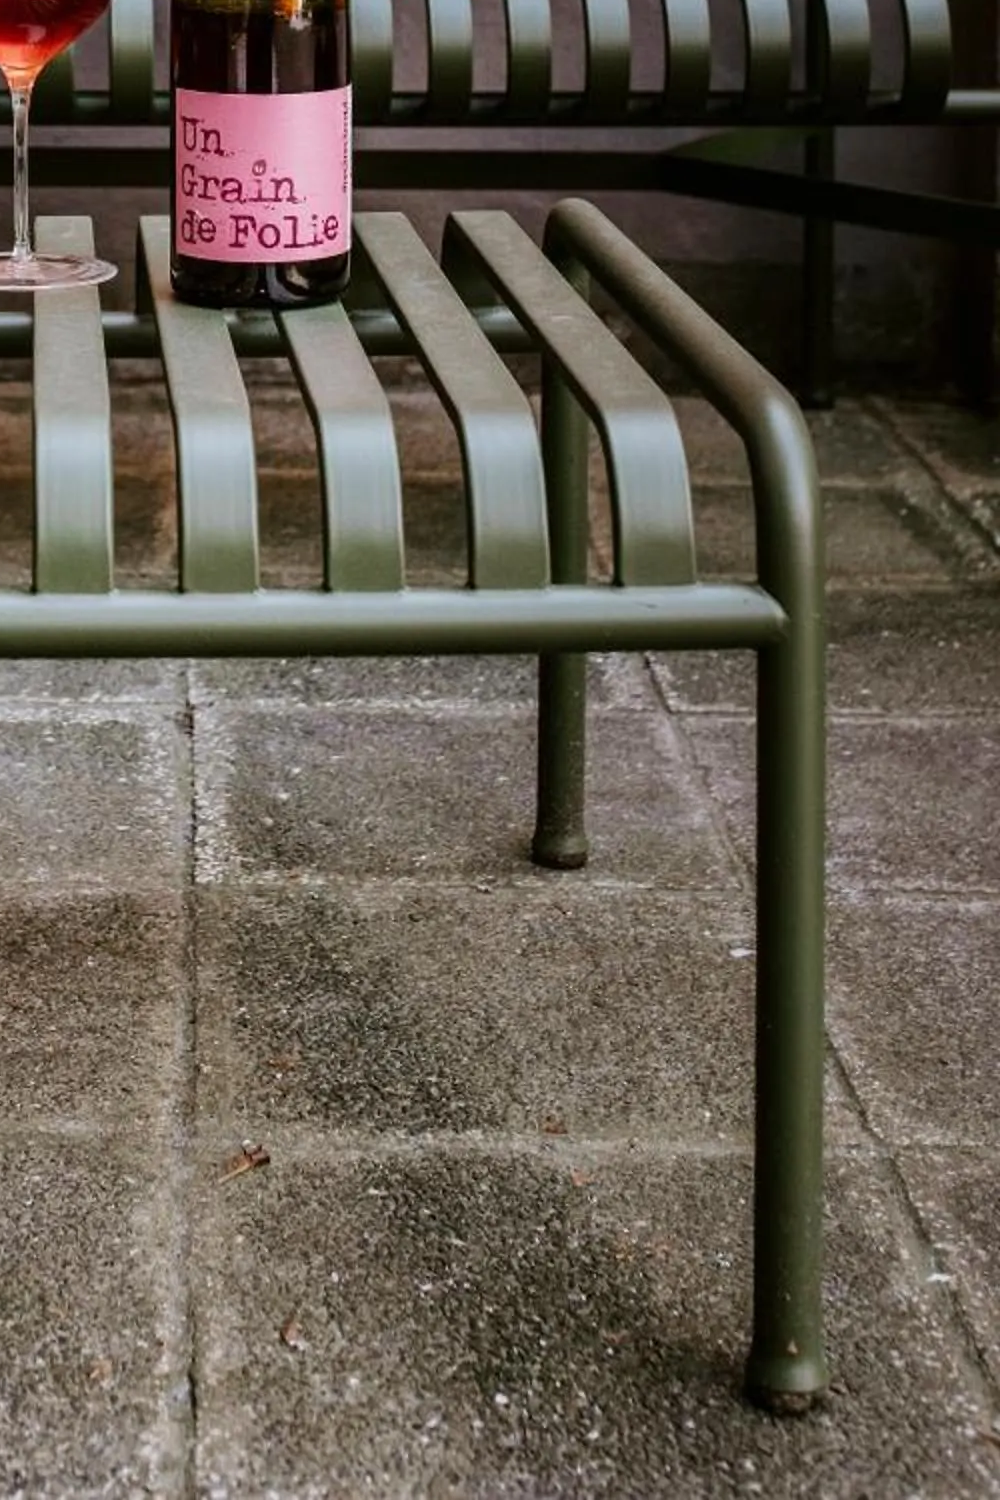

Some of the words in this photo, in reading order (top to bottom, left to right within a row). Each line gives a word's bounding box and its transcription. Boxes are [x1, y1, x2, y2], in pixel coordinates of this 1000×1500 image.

[181, 115, 226, 157] Un
[181, 159, 300, 205] Grain
[181, 209, 217, 245] de
[228, 213, 340, 250] Folie
